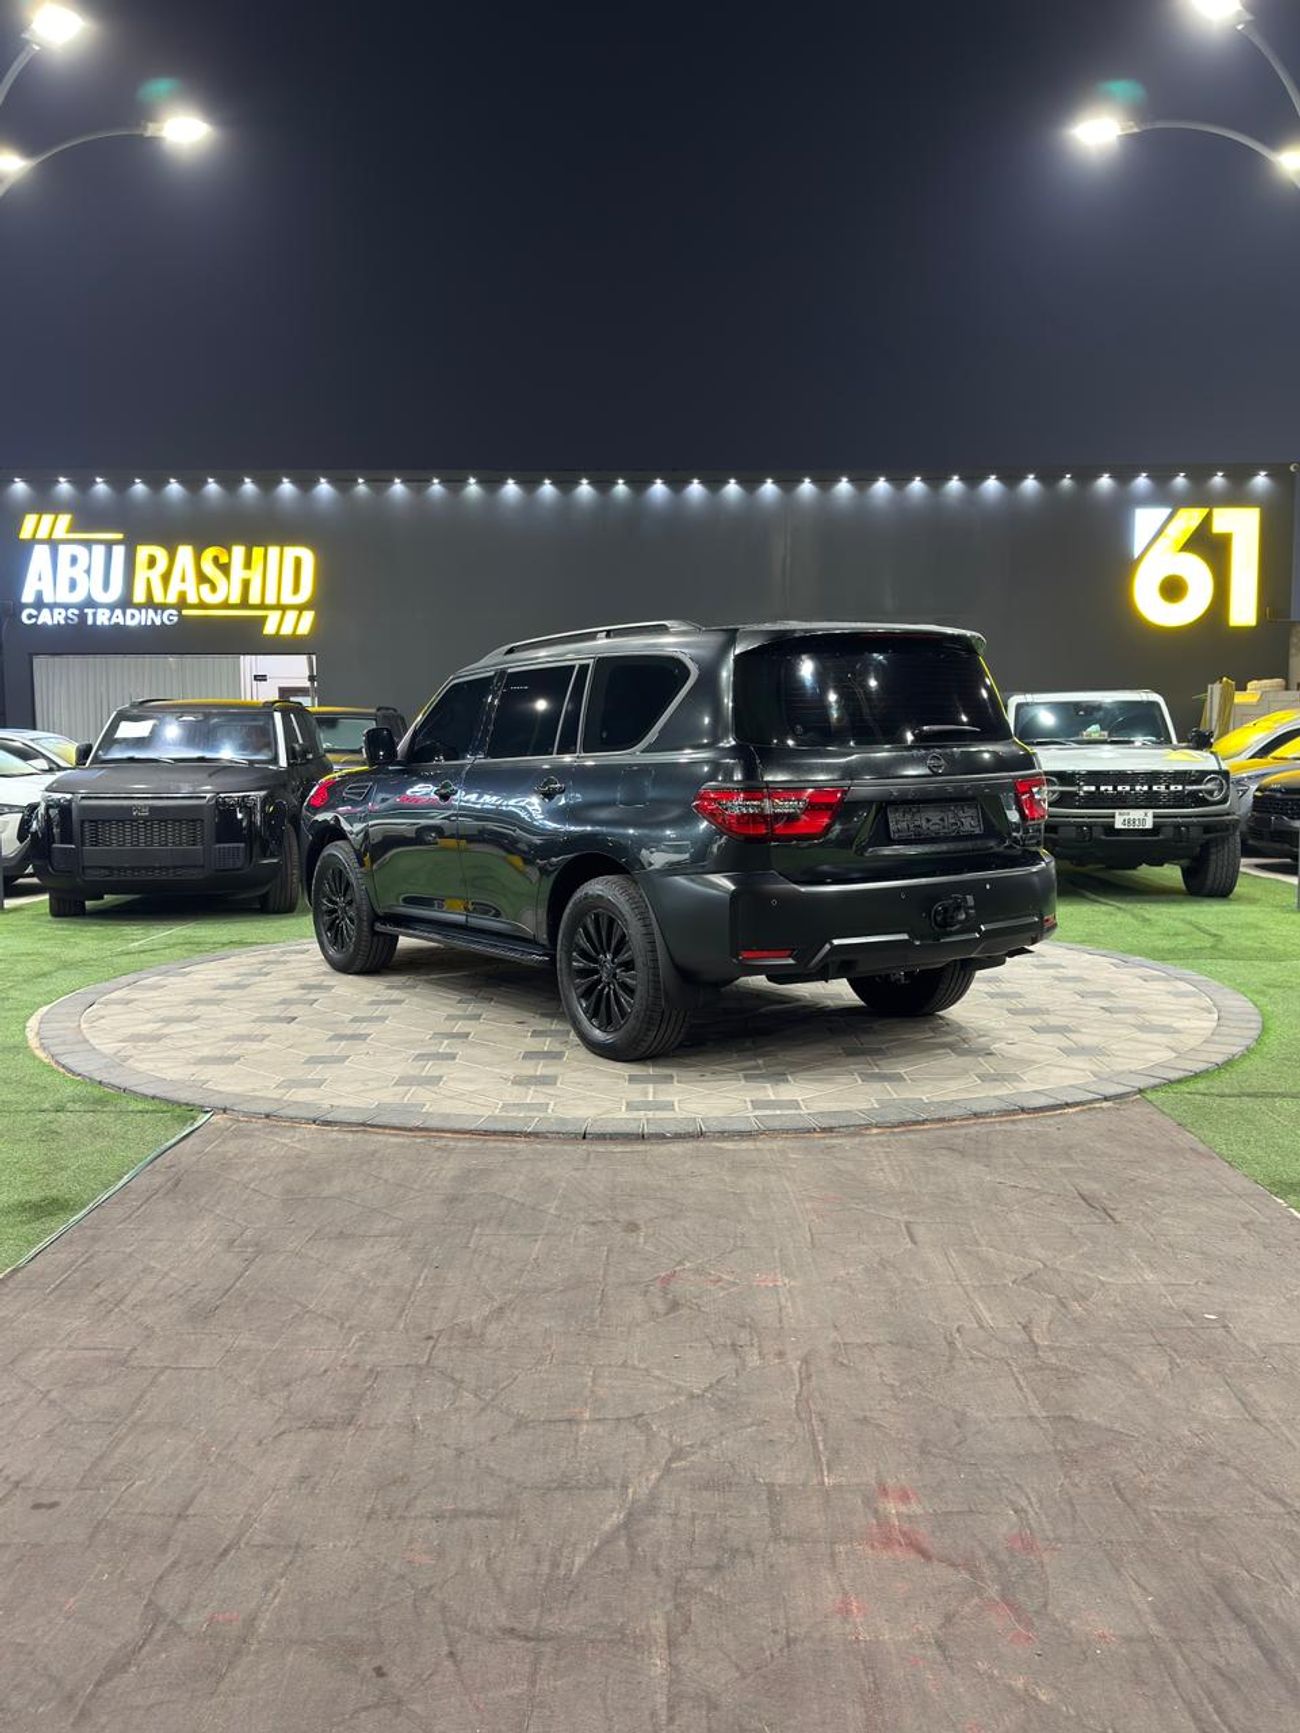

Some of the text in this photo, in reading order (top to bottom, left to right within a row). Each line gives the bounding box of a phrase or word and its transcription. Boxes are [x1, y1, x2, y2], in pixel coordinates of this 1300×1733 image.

[21, 544, 316, 605] ABU RASHID
[1133, 507, 1261, 627] 61
[21, 608, 178, 626] CARS TRADING
